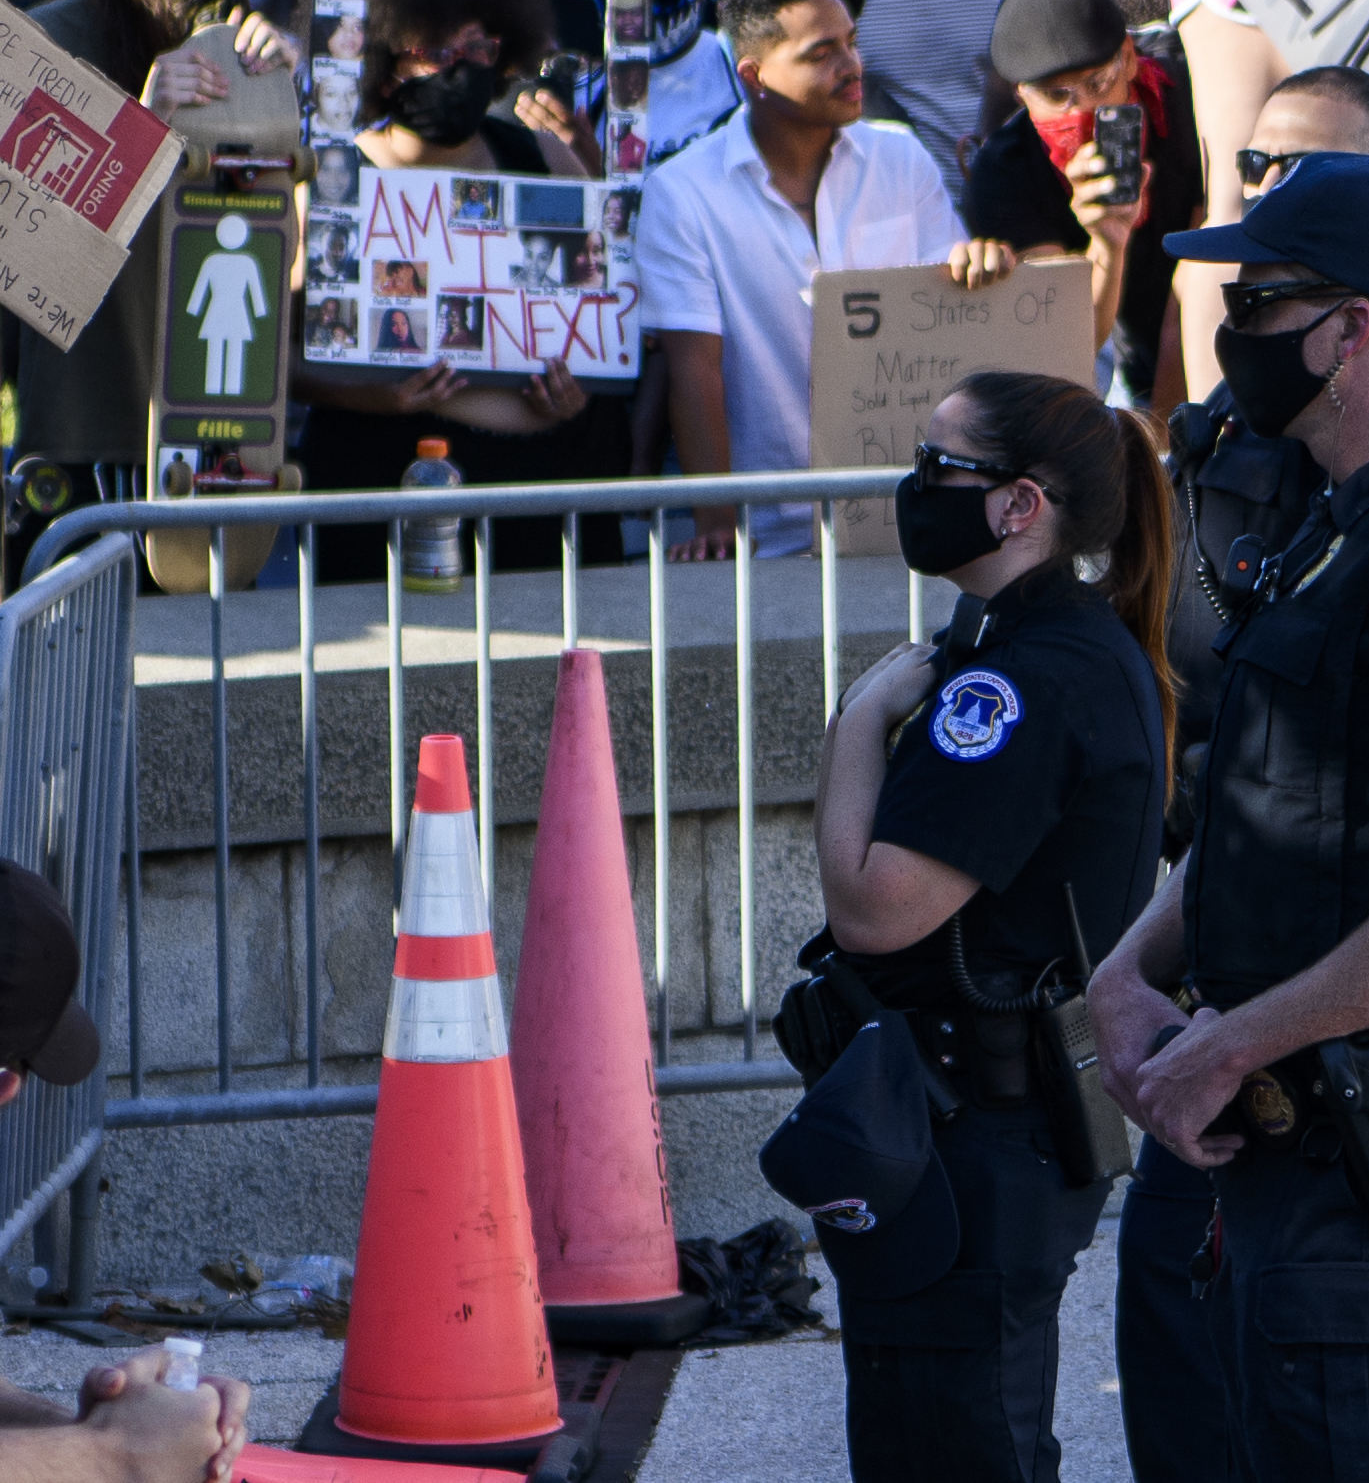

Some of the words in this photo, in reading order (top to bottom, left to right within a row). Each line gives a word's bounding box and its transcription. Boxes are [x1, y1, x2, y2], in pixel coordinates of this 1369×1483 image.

[27, 50, 91, 111] TIRED!!
[76, 159, 123, 216] ORING
[363, 176, 454, 265] AM
[440, 228, 517, 294] I
[27, 286, 75, 343] We're
[487, 280, 639, 370] NEXT?
[842, 292, 881, 339] 5
[910, 291, 991, 332] States
[1014, 286, 1057, 325] Of
[875, 350, 960, 385] Matter
[196, 419, 245, 439] fille
